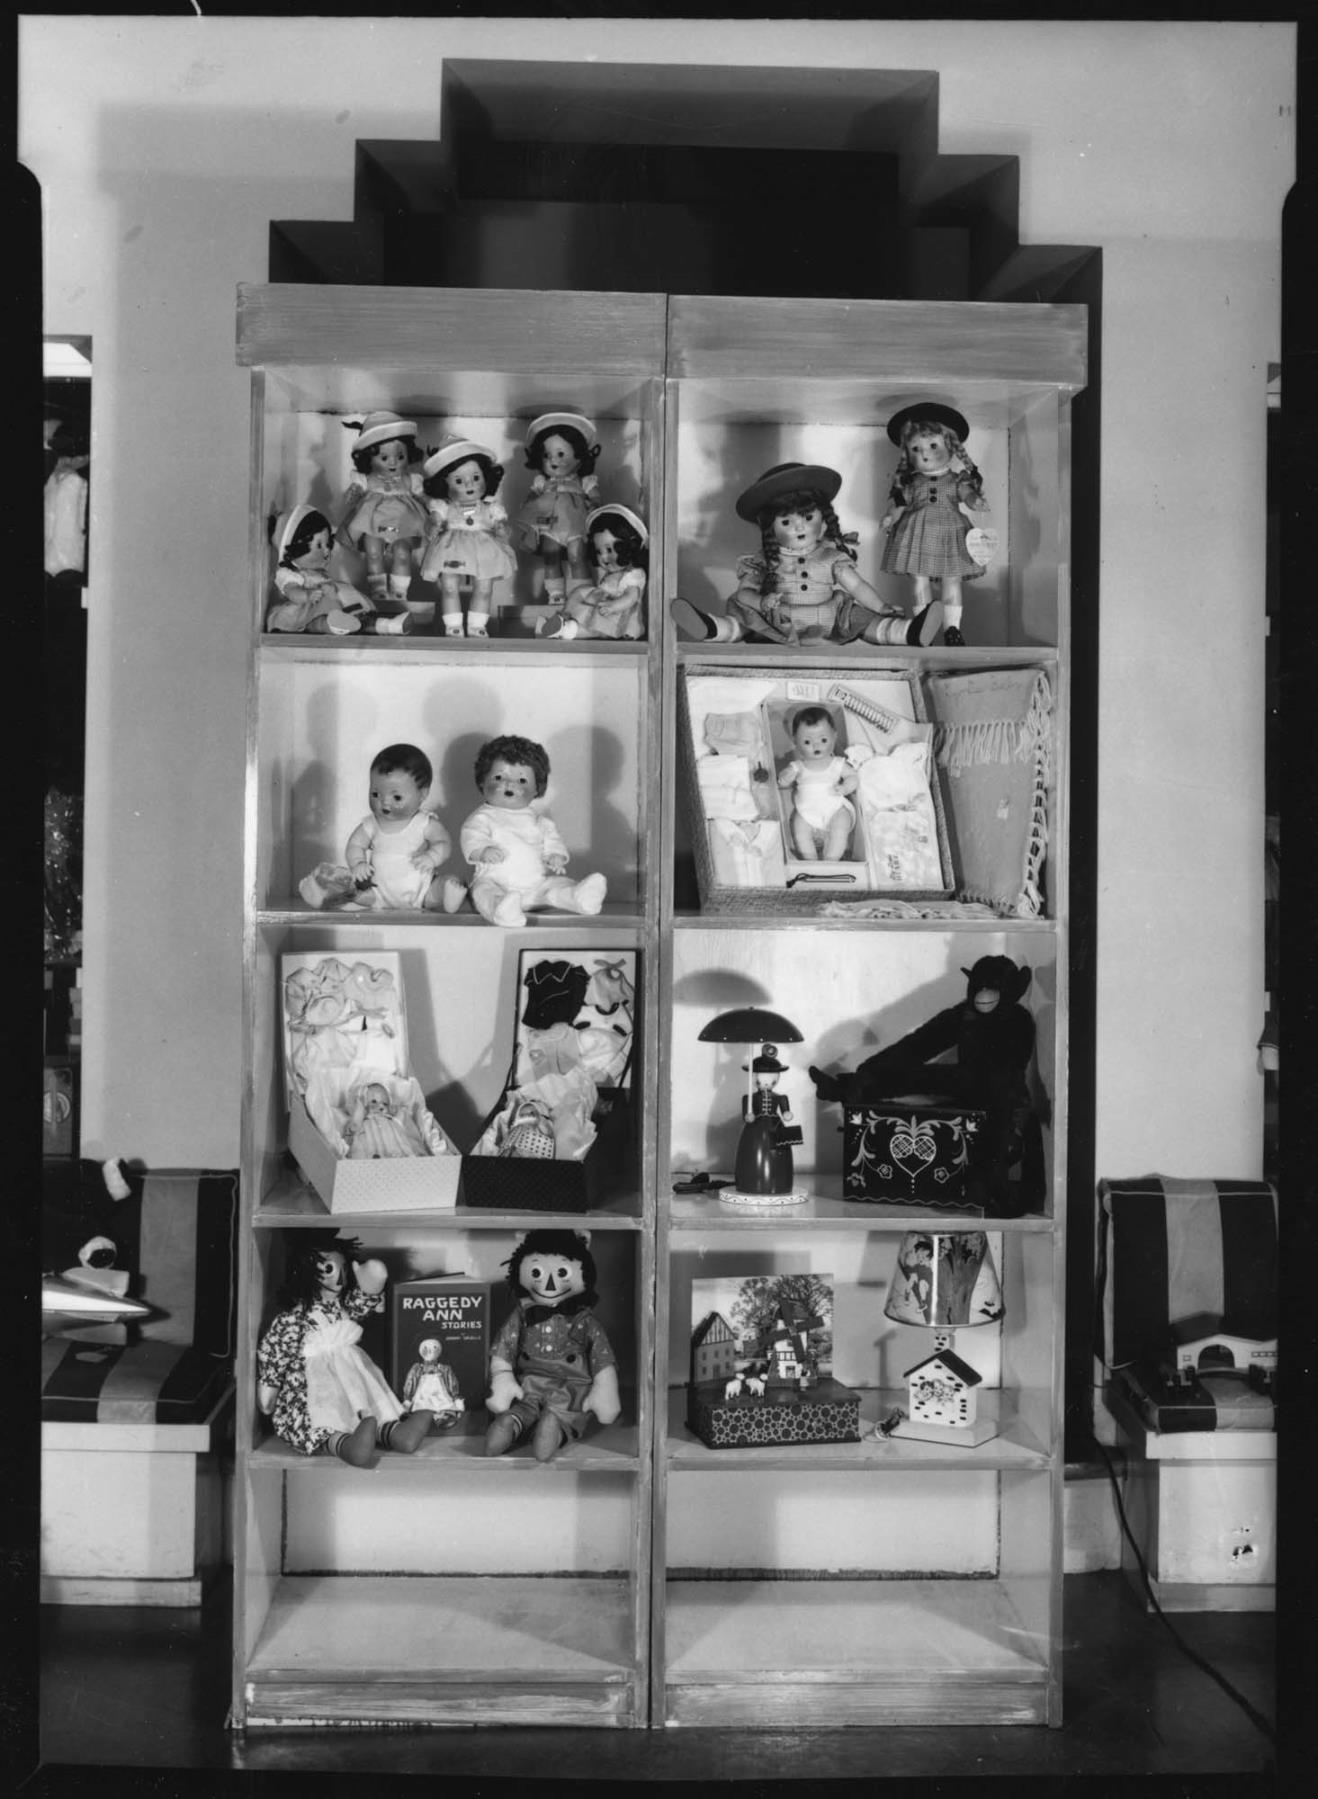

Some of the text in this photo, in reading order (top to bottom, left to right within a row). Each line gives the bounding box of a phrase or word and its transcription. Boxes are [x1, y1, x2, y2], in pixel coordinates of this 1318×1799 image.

[403, 1296, 482, 1309] RAGGEDY
[422, 1310, 462, 1321] ANN
[441, 1321, 482, 1329] STORIES
